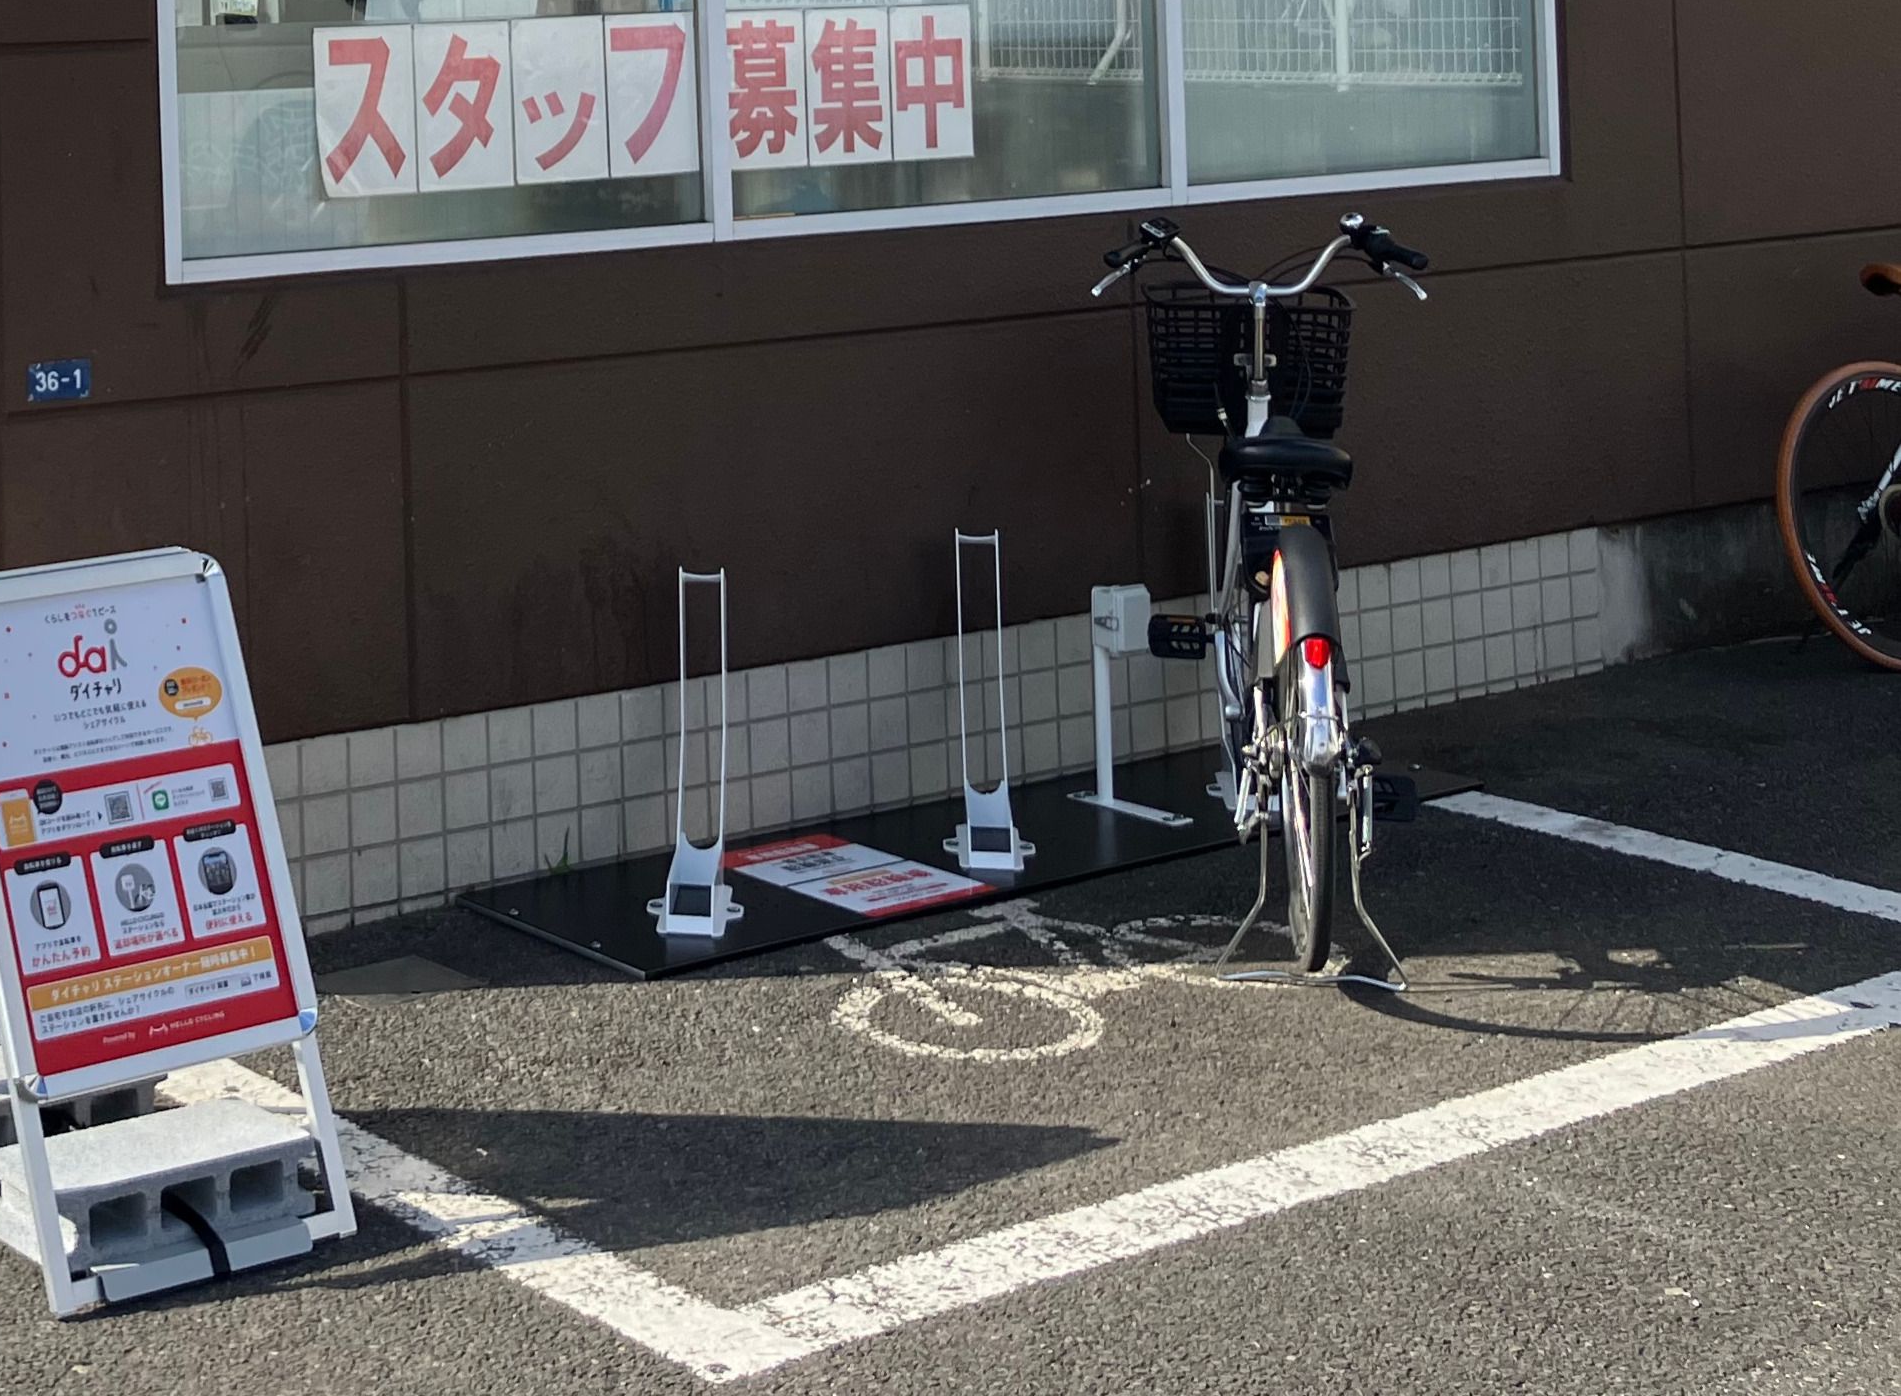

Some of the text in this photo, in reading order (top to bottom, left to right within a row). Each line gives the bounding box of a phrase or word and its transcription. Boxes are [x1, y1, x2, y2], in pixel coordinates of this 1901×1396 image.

[325, 15, 965, 185] スタッフ募集中
[35, 368, 82, 392] 36-1
[58, 620, 127, 677] dai
[70, 678, 122, 701] ダイチャリ
[169, 1019, 194, 1029] HELLO
